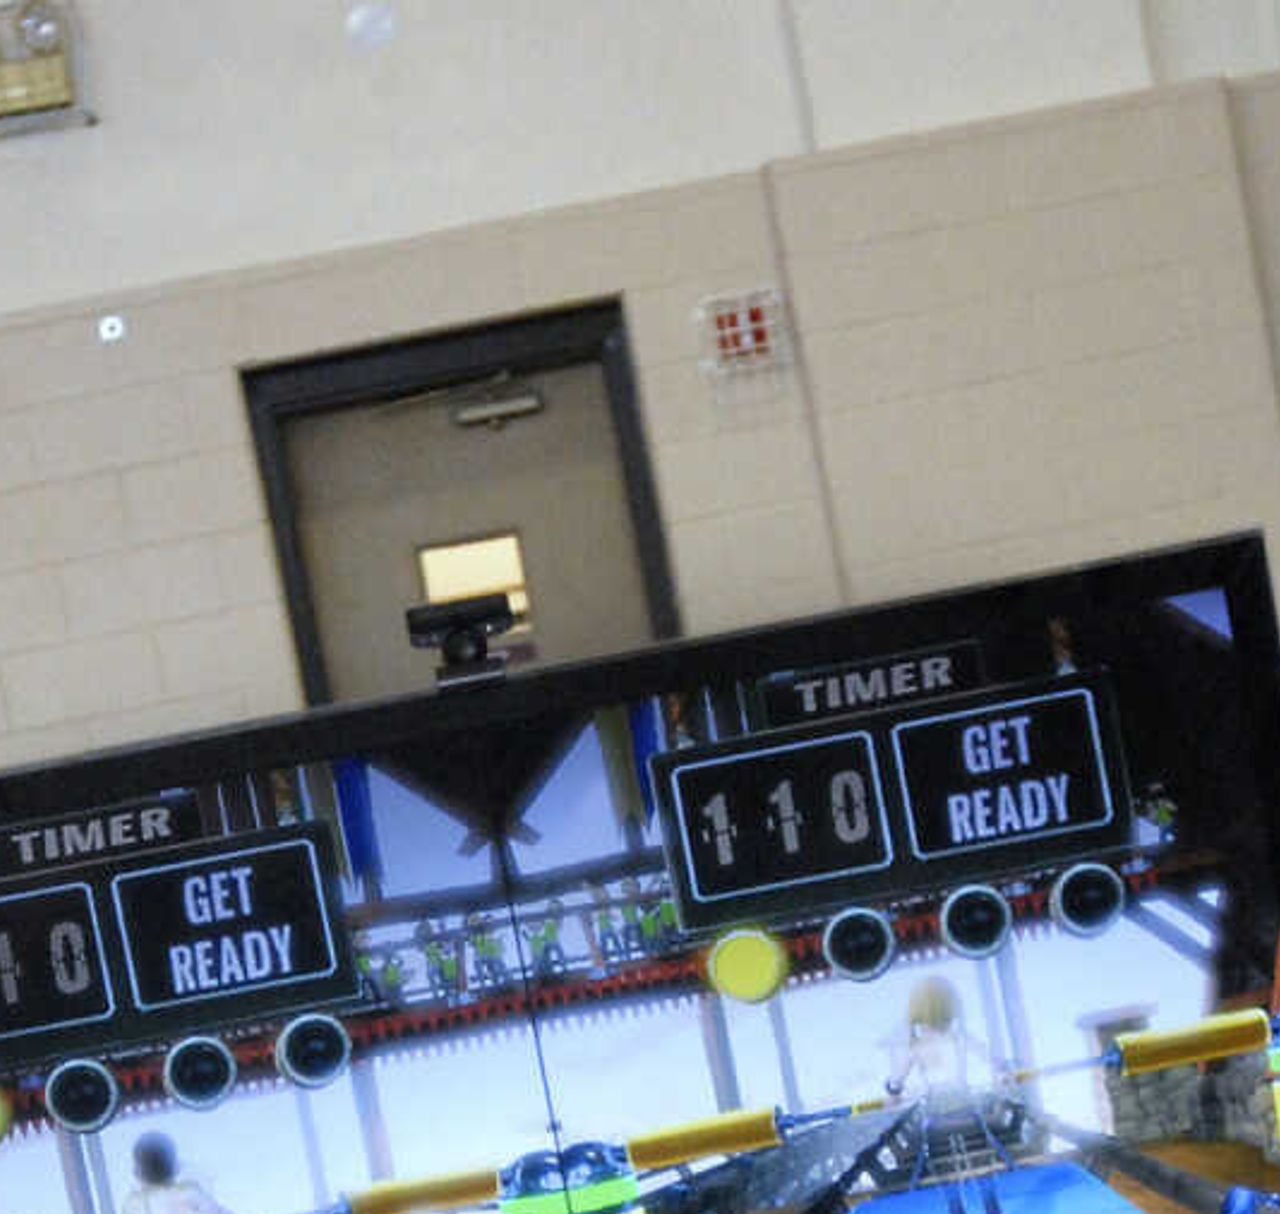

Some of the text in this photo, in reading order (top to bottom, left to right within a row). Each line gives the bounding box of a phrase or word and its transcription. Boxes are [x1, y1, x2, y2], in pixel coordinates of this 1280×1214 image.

[793, 657, 954, 713] TIMER
[962, 715, 1032, 775] GET
[11, 807, 173, 864] TIMER
[947, 772, 1070, 844] READY
[183, 866, 253, 926] GET
[169, 923, 292, 995] READY
